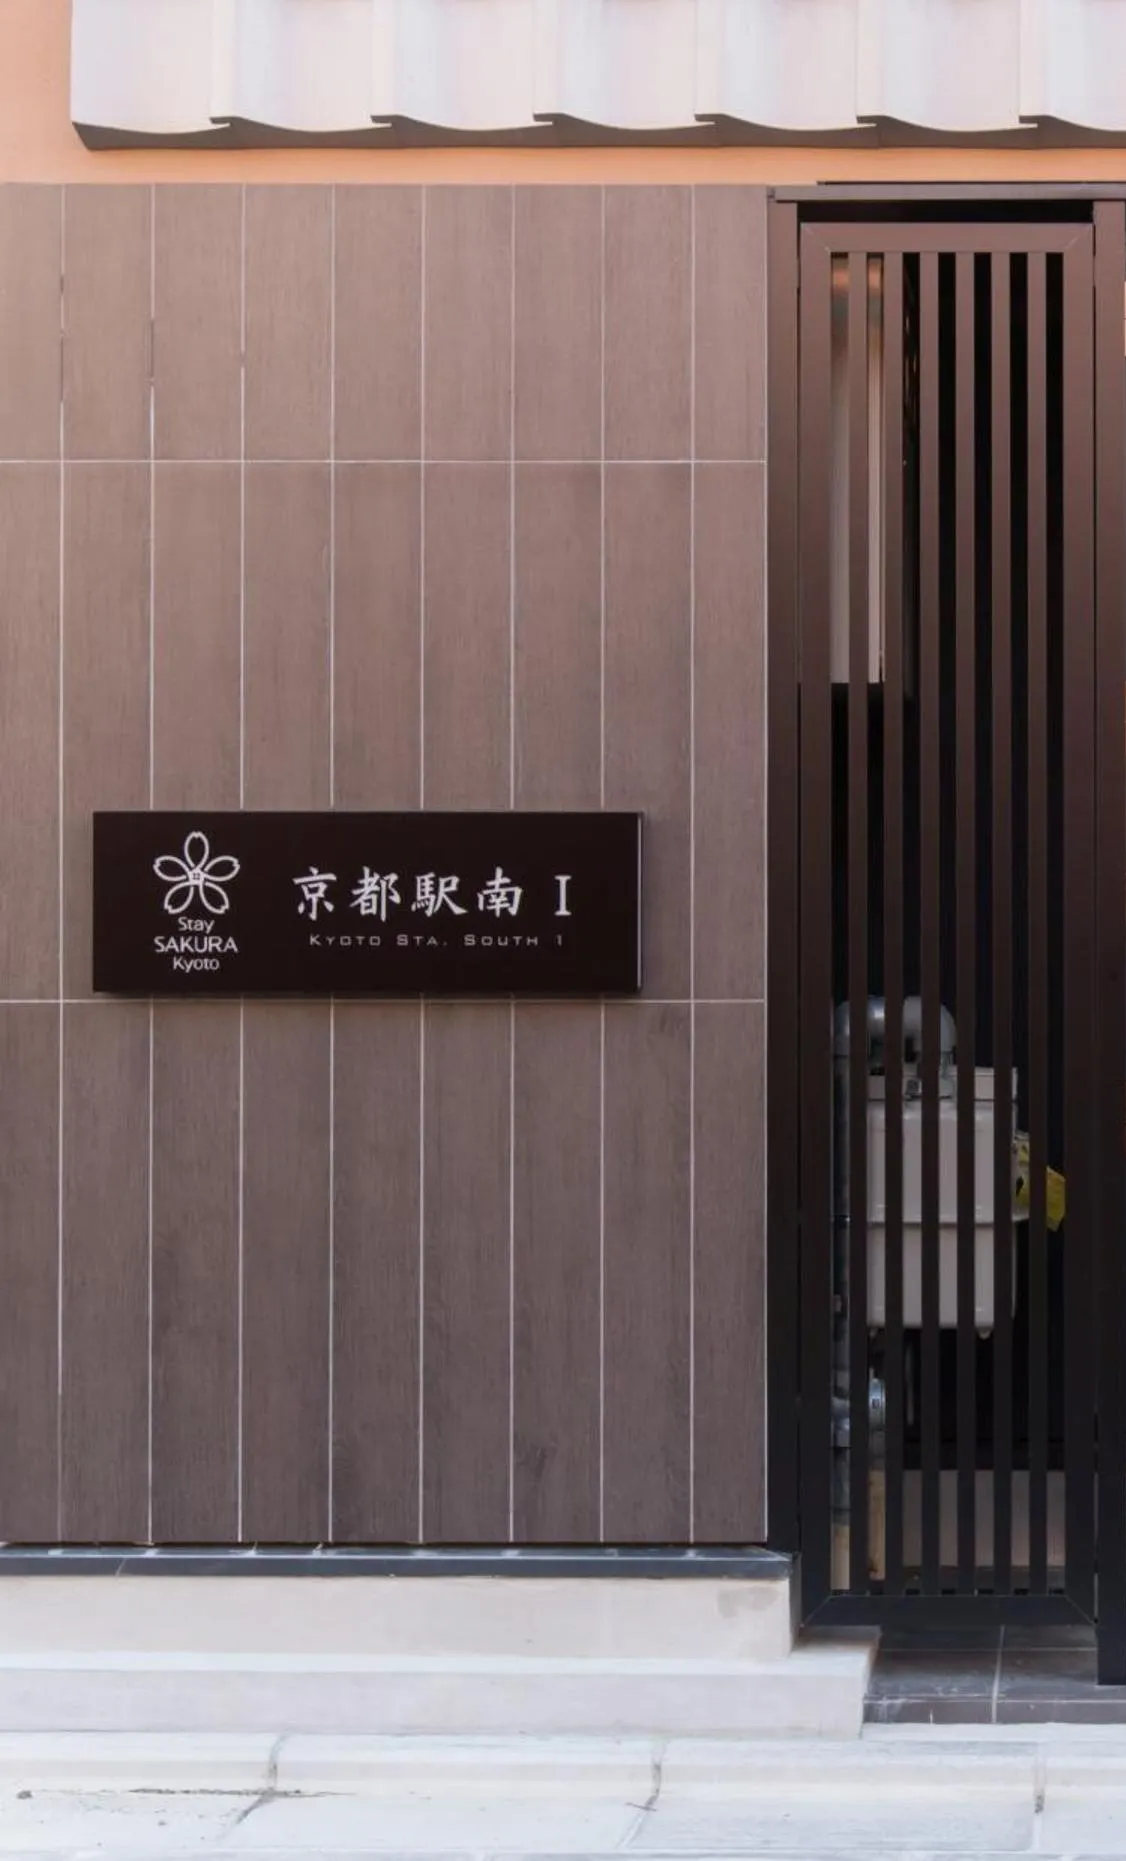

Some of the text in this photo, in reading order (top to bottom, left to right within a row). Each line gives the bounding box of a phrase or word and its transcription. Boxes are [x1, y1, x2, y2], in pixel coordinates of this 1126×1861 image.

[292, 866, 523, 923] 京都駅南
[177, 916, 215, 935] Stay
[153, 935, 239, 954] SAKURA
[172, 955, 220, 974] Kyoto
